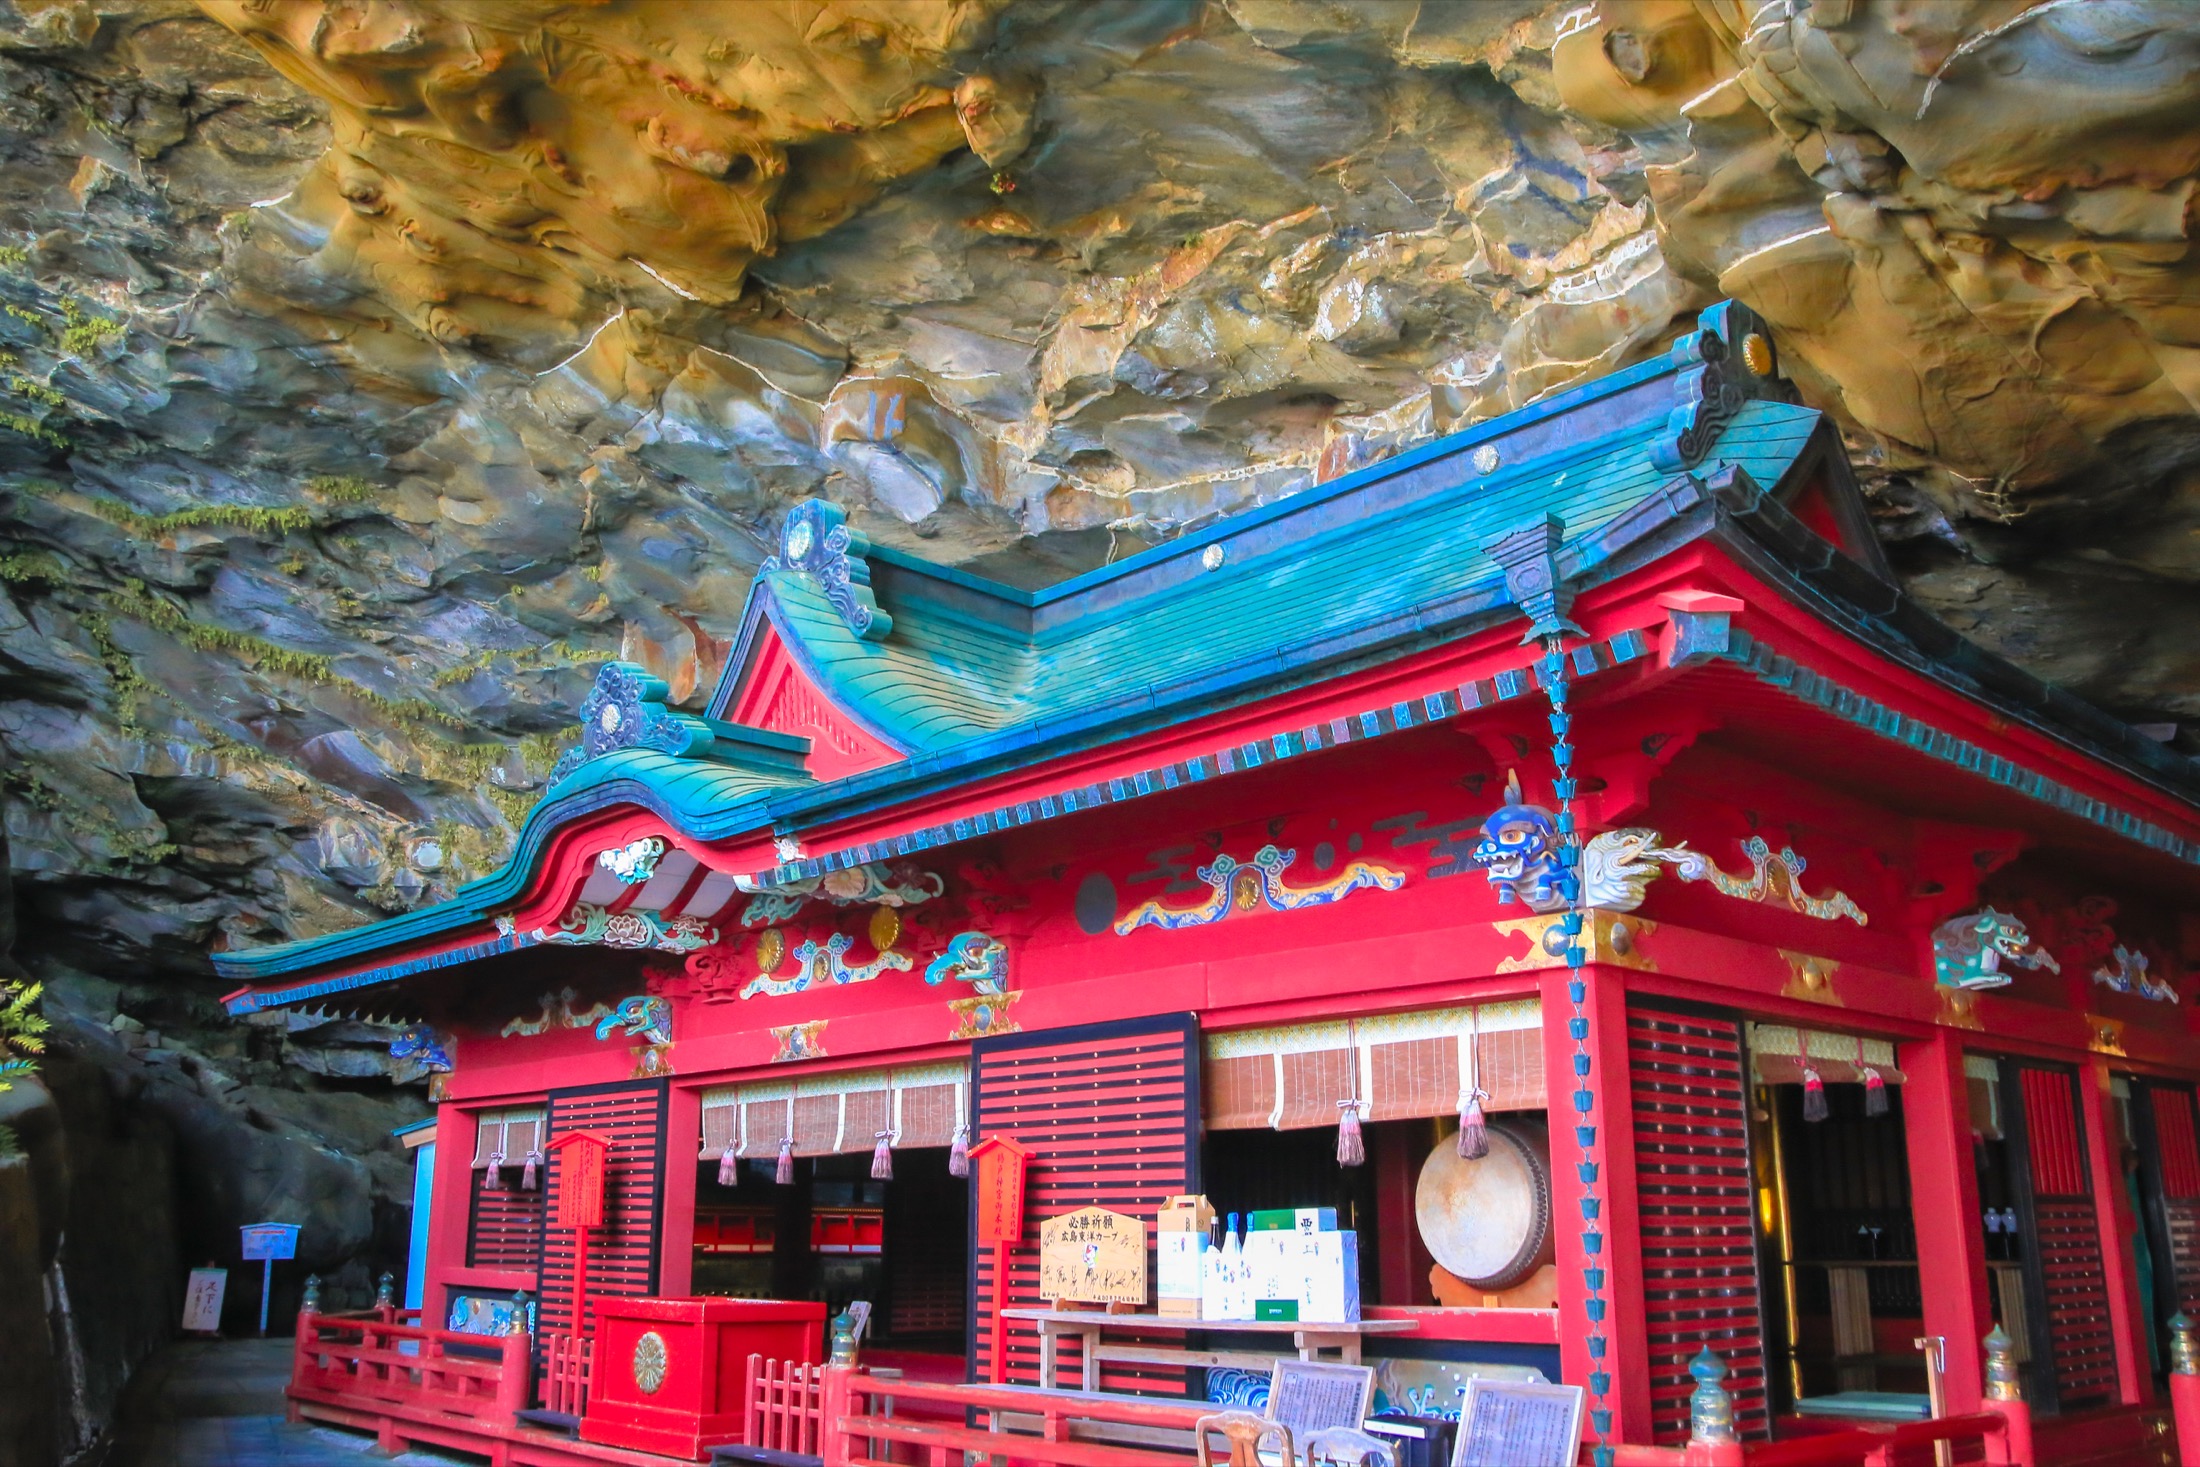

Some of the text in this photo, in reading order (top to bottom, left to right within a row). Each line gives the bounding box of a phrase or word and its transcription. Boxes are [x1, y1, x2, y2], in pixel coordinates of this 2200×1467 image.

[1068, 1214, 1114, 1230] 必勝祈願
[202, 1281, 218, 1315] 足下に
